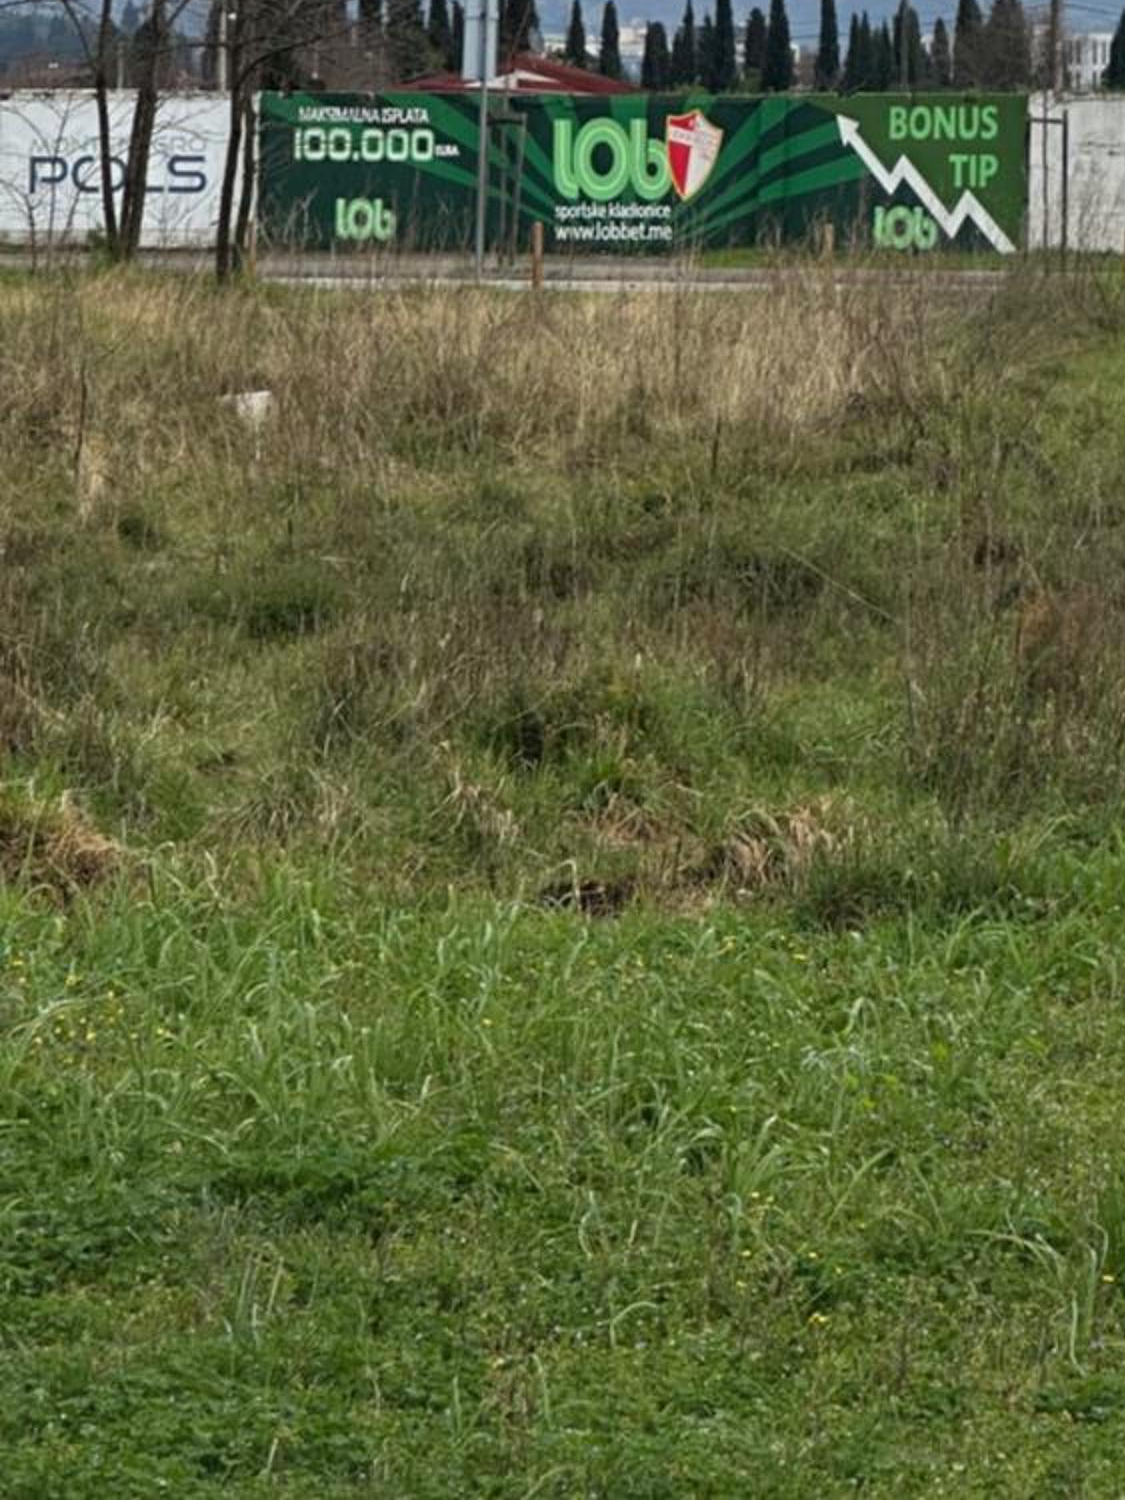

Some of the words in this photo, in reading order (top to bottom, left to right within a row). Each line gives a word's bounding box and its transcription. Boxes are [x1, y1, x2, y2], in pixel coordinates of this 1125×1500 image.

[889, 105, 999, 140] BONUS
[294, 127, 435, 162] 100.000
[948, 153, 999, 188] TIP
[555, 220, 673, 241] www.lobbet.me
